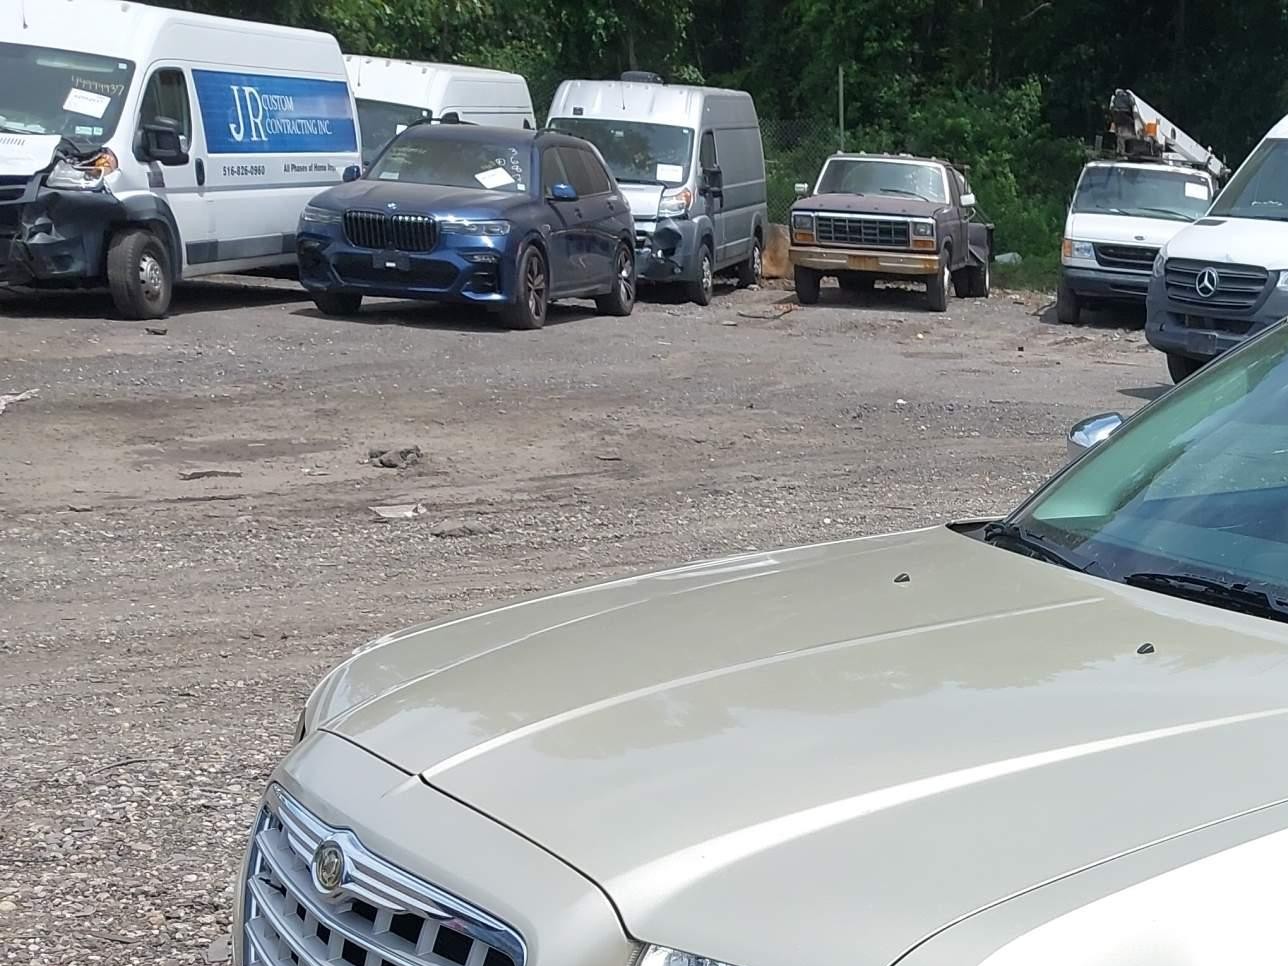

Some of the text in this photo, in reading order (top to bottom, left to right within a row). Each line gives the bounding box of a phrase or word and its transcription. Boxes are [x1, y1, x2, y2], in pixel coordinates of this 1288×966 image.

[262, 94, 294, 112] CUSTOM
[266, 118, 317, 134] CONTRACTING
[223, 165, 266, 177] 516-826-0960
